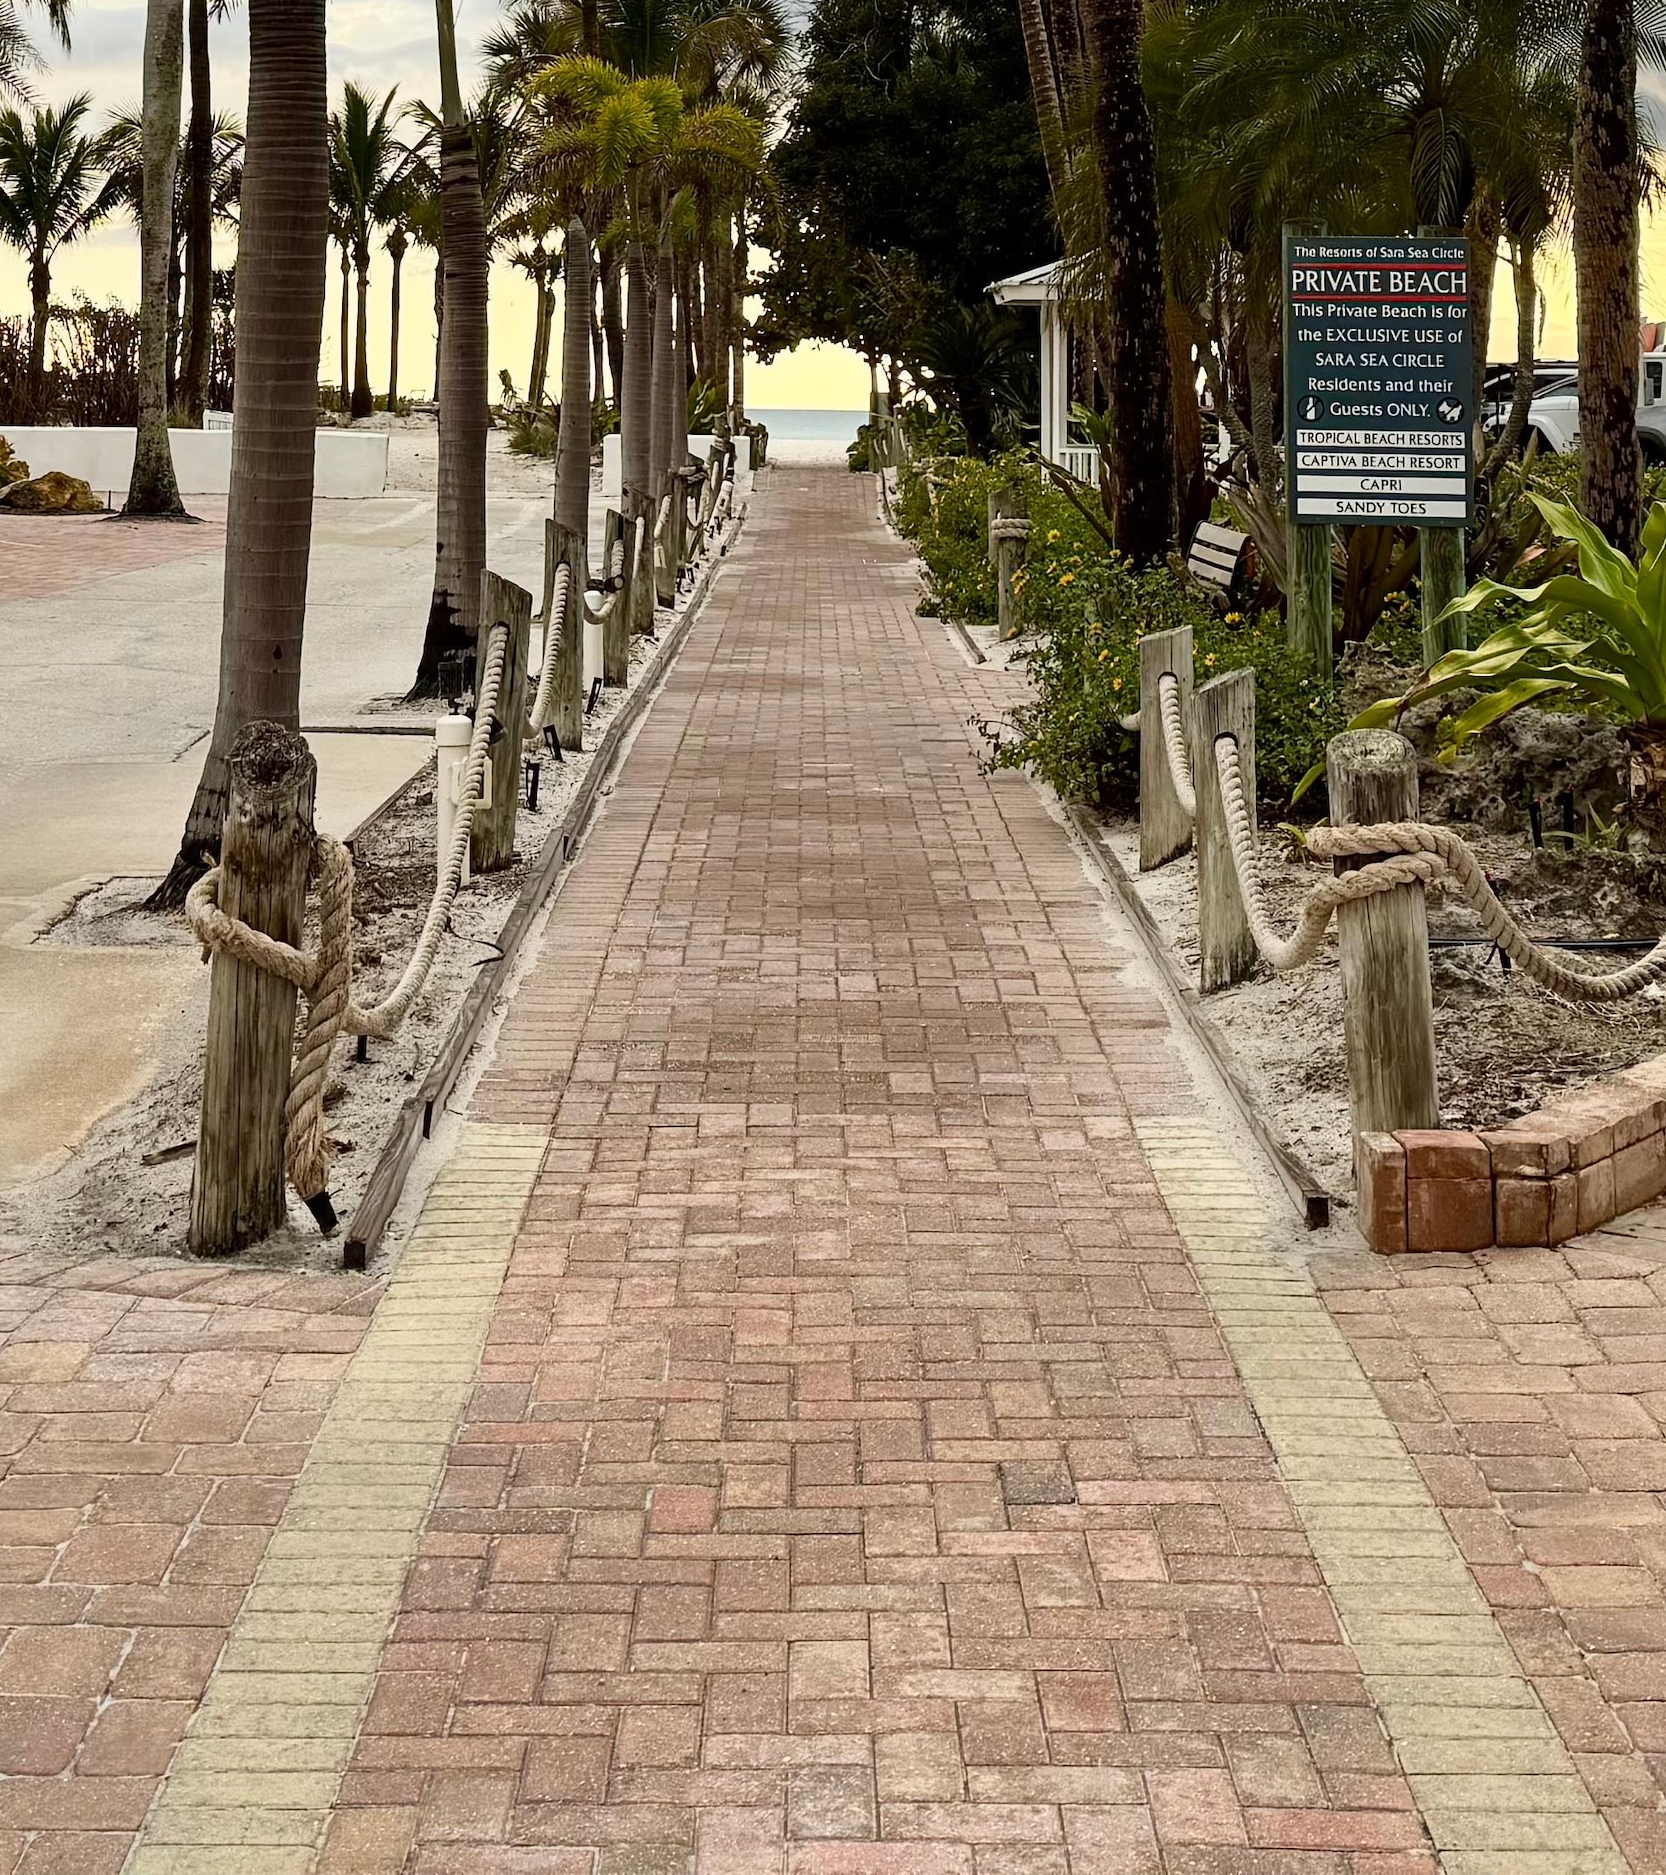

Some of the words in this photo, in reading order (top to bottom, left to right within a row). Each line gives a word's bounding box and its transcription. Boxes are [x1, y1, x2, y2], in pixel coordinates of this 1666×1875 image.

[1294, 246, 1316, 258] The
[1319, 246, 1362, 258] Resorts
[1366, 246, 1378, 258] of
[1379, 246, 1405, 259] Sara
[1407, 247, 1429, 259] Sea
[1432, 247, 1465, 259] Circle
[1292, 270, 1382, 293] PRIVATE
[1389, 271, 1467, 294] BEACH
[1292, 303, 1323, 317] This
[1327, 304, 1377, 318] Private
[1381, 304, 1427, 318] Beach
[1431, 305, 1443, 318] is
[1447, 305, 1468, 318] for
[1297, 328, 1322, 342] the
[1326, 328, 1410, 342] EXCLUSIVE
[1414, 329, 1444, 343] USE
[1447, 329, 1463, 343] of
[1315, 352, 1356, 367] SARA
[1359, 353, 1389, 367] SEA
[1392, 354, 1445, 368] CIRCLE
[1308, 377, 1381, 392] Residents
[1385, 379, 1414, 392] and
[1418, 379, 1453, 393] their
[1330, 402, 1382, 416] Guests
[1387, 403, 1431, 417] ONLY.
[1300, 432, 1360, 444] TROPICAL
[1364, 433, 1405, 445] BEACH
[1409, 434, 1462, 446] RESORTS
[1301, 455, 1357, 467] CAPTIVA
[1361, 456, 1406, 468] BEACH
[1410, 457, 1460, 469] RESORT
[1360, 479, 1402, 491] CAPRI
[1336, 501, 1385, 514] SANDY
[1391, 502, 1426, 515] TOES
